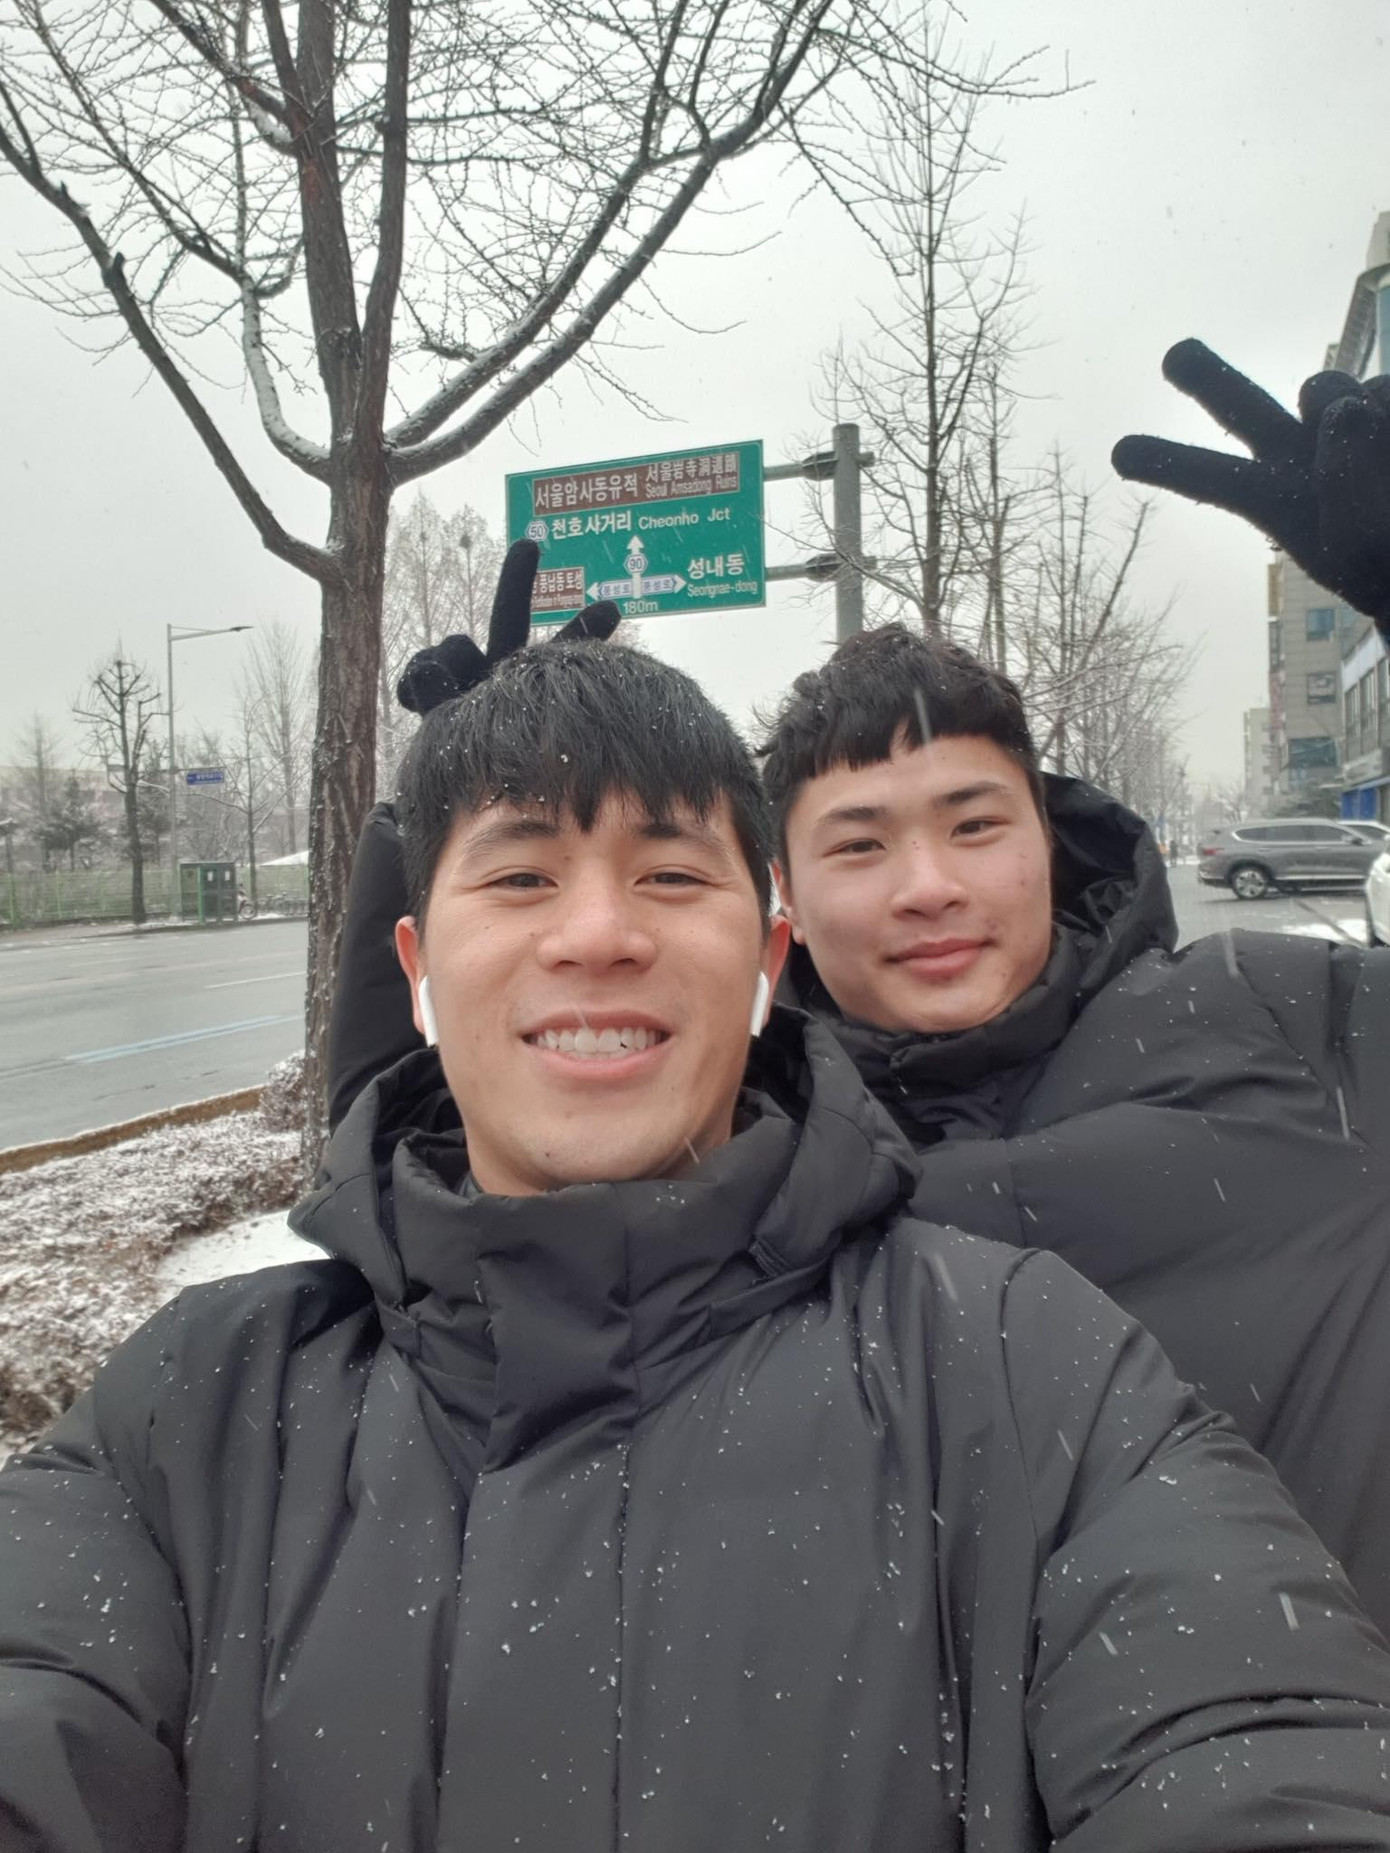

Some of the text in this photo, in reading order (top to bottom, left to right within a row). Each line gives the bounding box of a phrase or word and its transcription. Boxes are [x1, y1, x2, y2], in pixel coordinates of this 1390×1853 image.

[535, 473, 638, 509] 서울암사동유적
[645, 475, 737, 498] Seoul Amsadong Ruins
[551, 510, 632, 540] 천호사거리
[638, 507, 730, 530] Cheonho Jct
[530, 525, 544, 539] 50
[629, 557, 643, 570] 90
[687, 553, 745, 579] 성내동
[687, 579, 758, 599] Seongnae-dong
[622, 600, 659, 615] 180m
